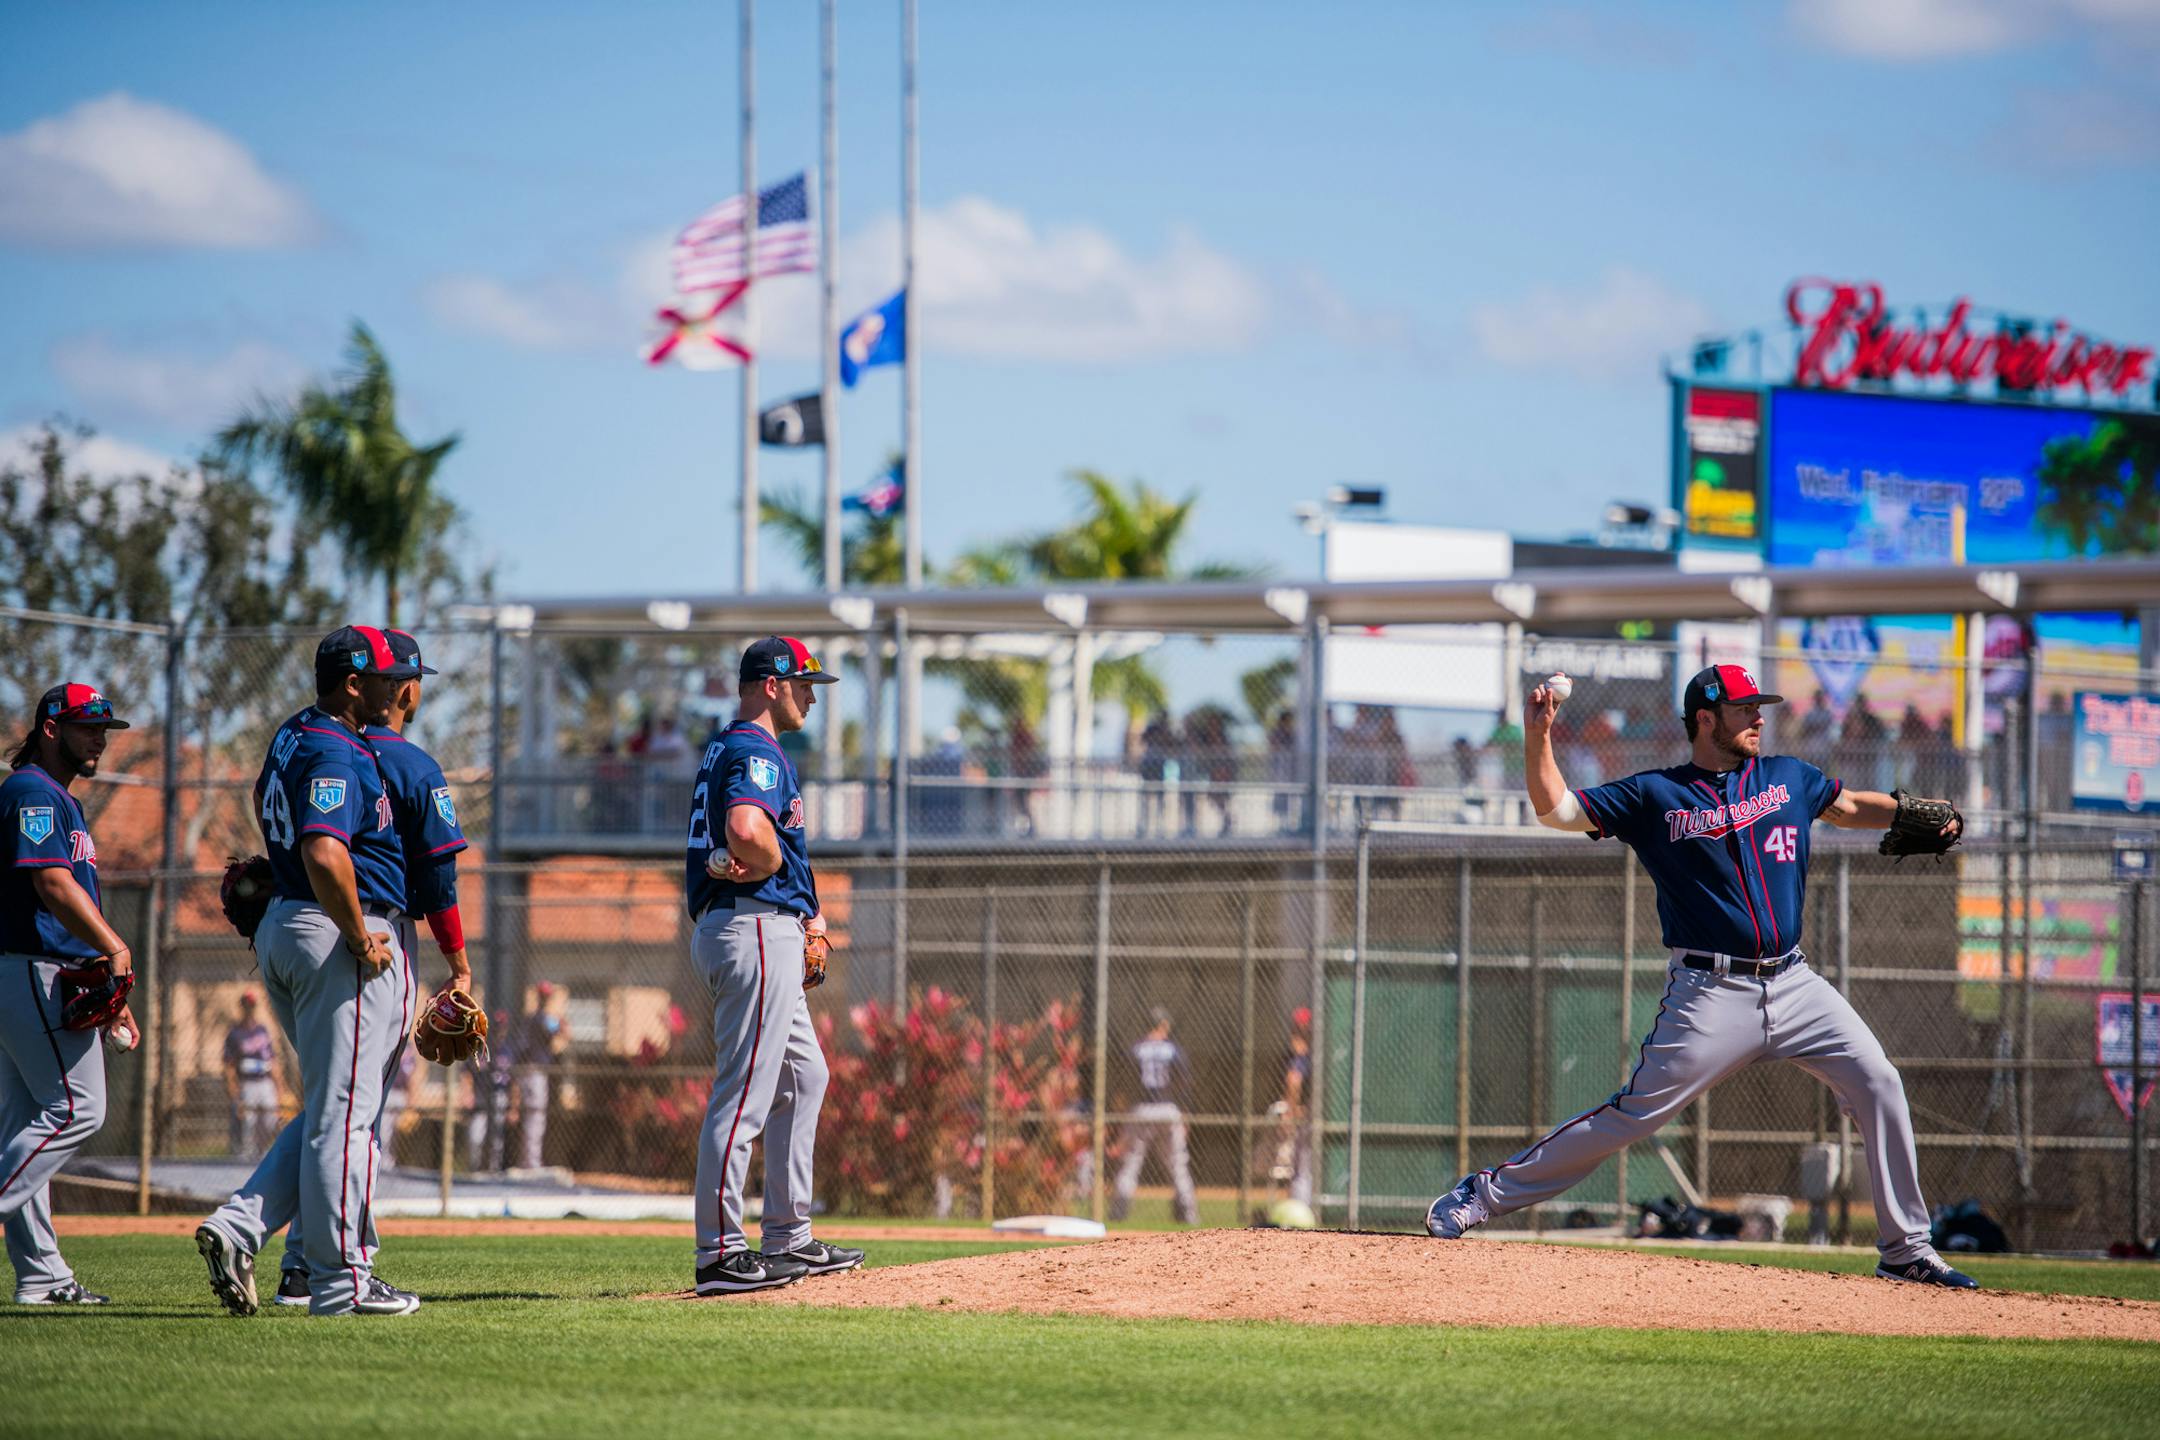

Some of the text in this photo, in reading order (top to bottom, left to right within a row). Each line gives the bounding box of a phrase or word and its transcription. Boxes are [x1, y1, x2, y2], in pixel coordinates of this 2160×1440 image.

[1785, 276, 2155, 394] Budweiser
[29, 823, 42, 832] FL
[261, 769, 295, 850] 49
[1664, 783, 1791, 844] Minnesota
[1763, 825, 1799, 863] 45
